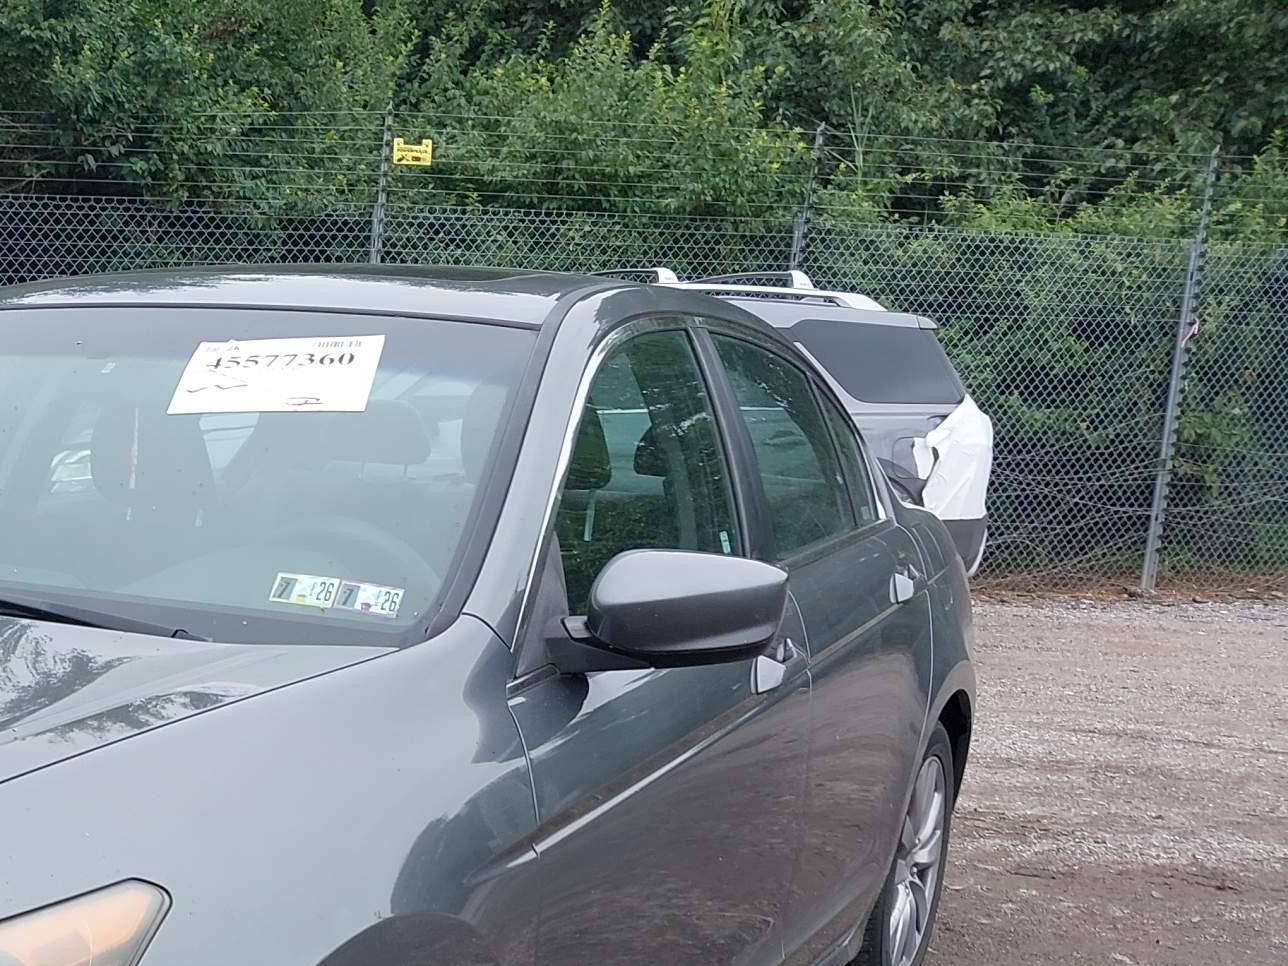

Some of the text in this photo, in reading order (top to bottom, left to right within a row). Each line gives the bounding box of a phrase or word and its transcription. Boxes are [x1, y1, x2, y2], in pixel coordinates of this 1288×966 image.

[206, 352, 355, 370] 45577360
[316, 581, 335, 602] 26
[380, 590, 400, 612] 26
